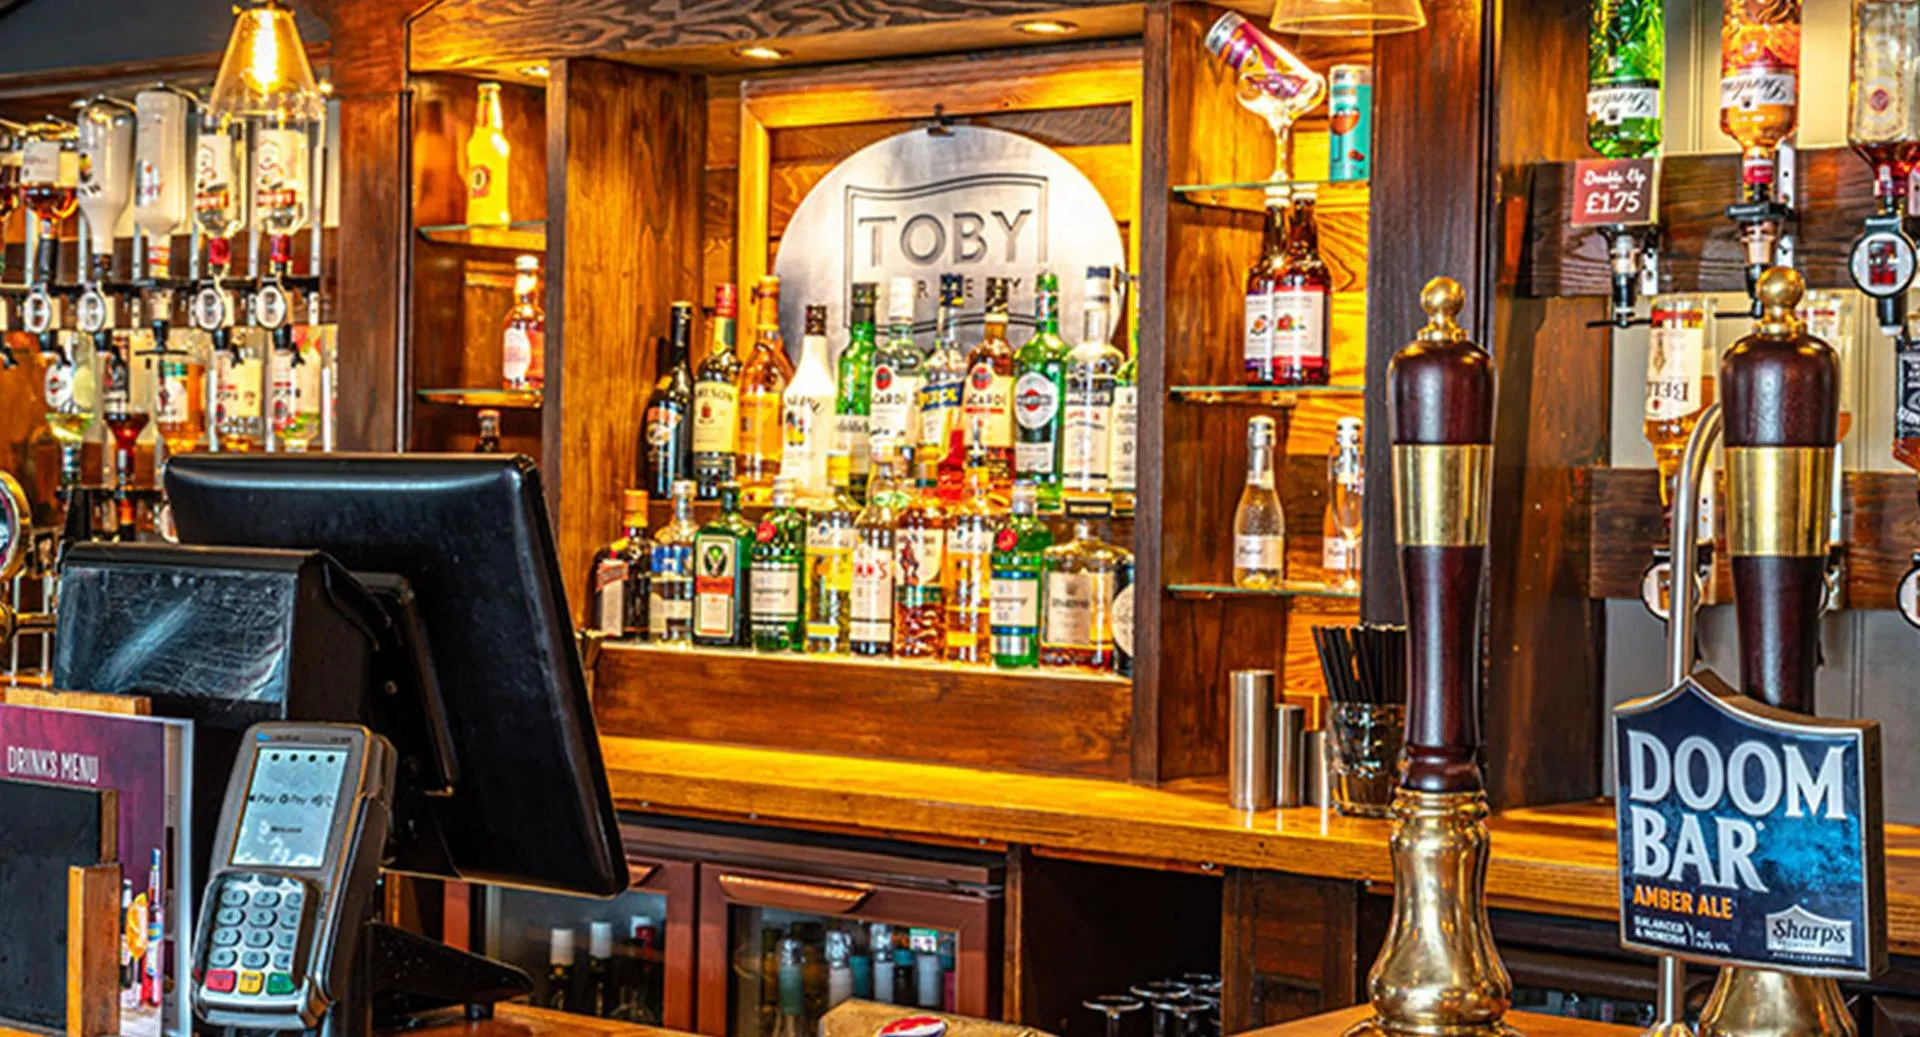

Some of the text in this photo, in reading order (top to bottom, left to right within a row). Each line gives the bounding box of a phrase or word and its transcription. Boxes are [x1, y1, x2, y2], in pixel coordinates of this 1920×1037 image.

[1583, 167, 1647, 189] Double Up
[858, 208, 1032, 267] TOBY
[7, 745, 98, 784] DRINKS MENU
[1626, 729, 1850, 820] DOOM
[1632, 884, 1734, 921] AMBER ALE
[1772, 918, 1846, 947] Sharp's
